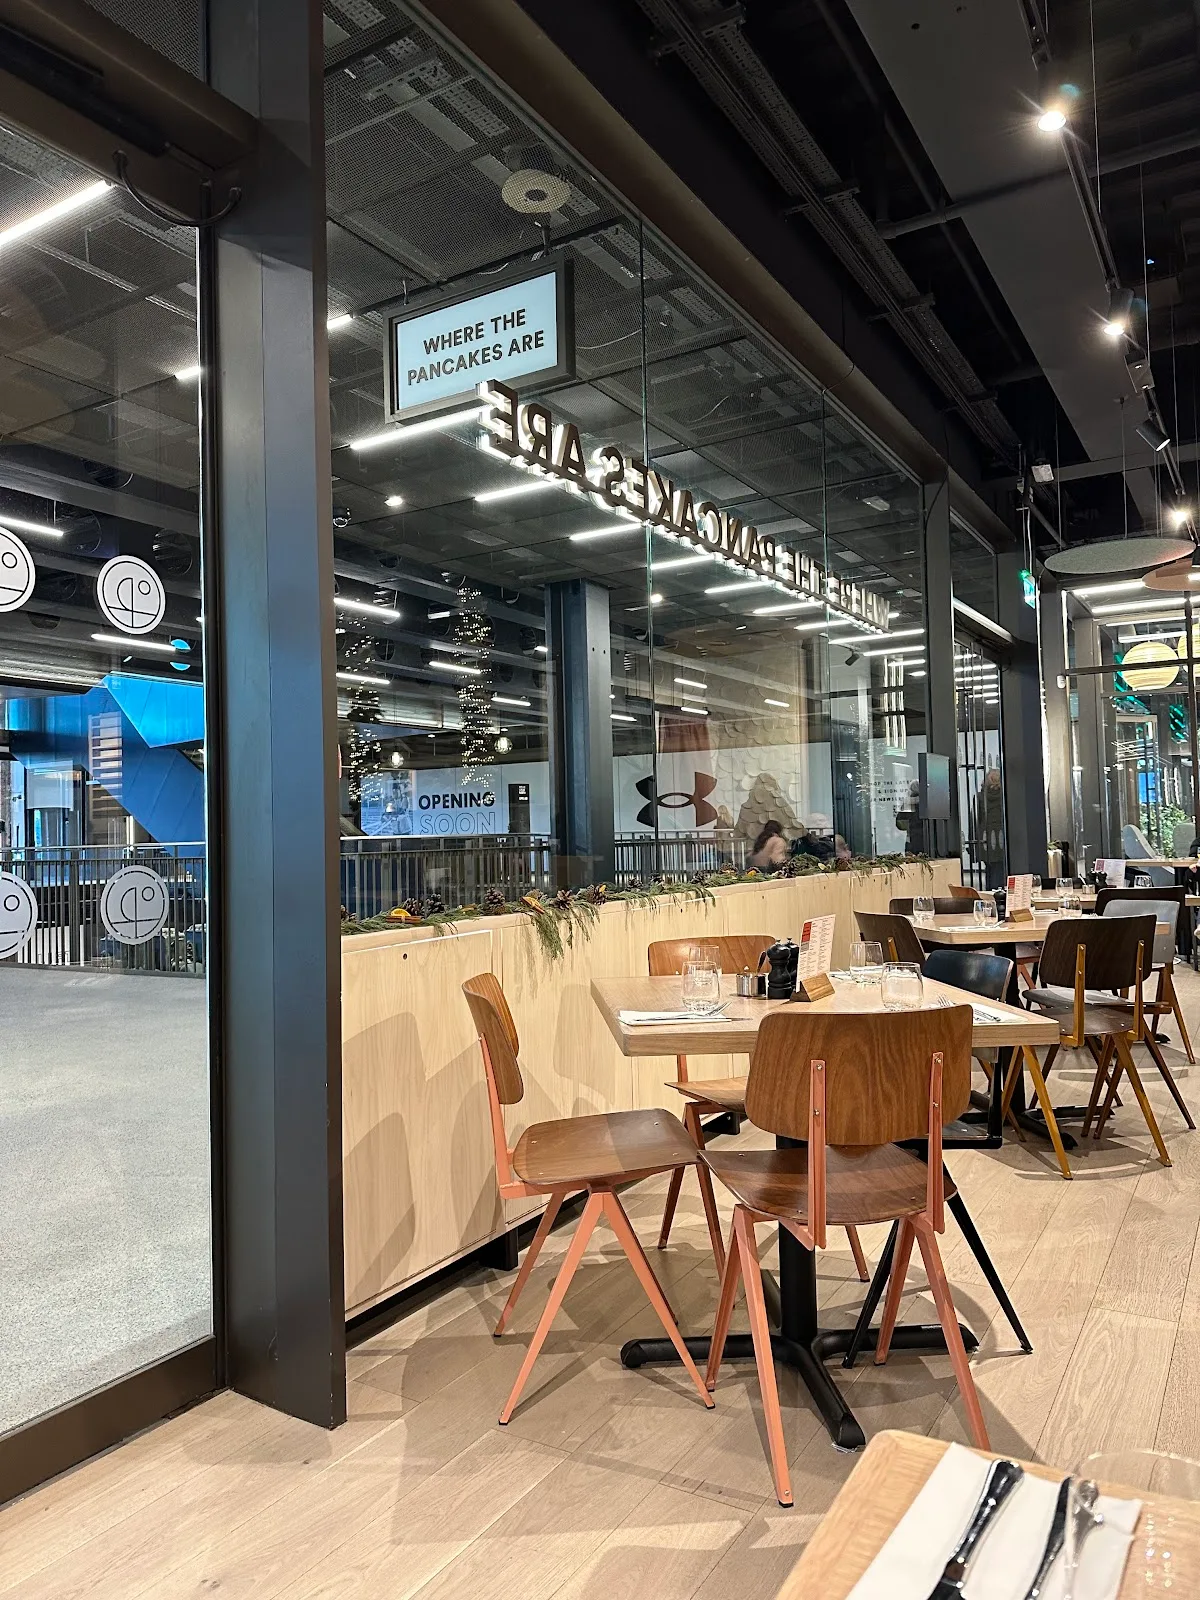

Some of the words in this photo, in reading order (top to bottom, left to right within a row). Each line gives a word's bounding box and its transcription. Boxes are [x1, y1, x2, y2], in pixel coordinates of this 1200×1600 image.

[423, 321, 485, 355] WHERE
[490, 308, 526, 334] THE
[407, 343, 503, 386] PANCAKES
[508, 329, 545, 357] ARE
[418, 791, 496, 811] OPENING
[420, 811, 496, 835] SOON
